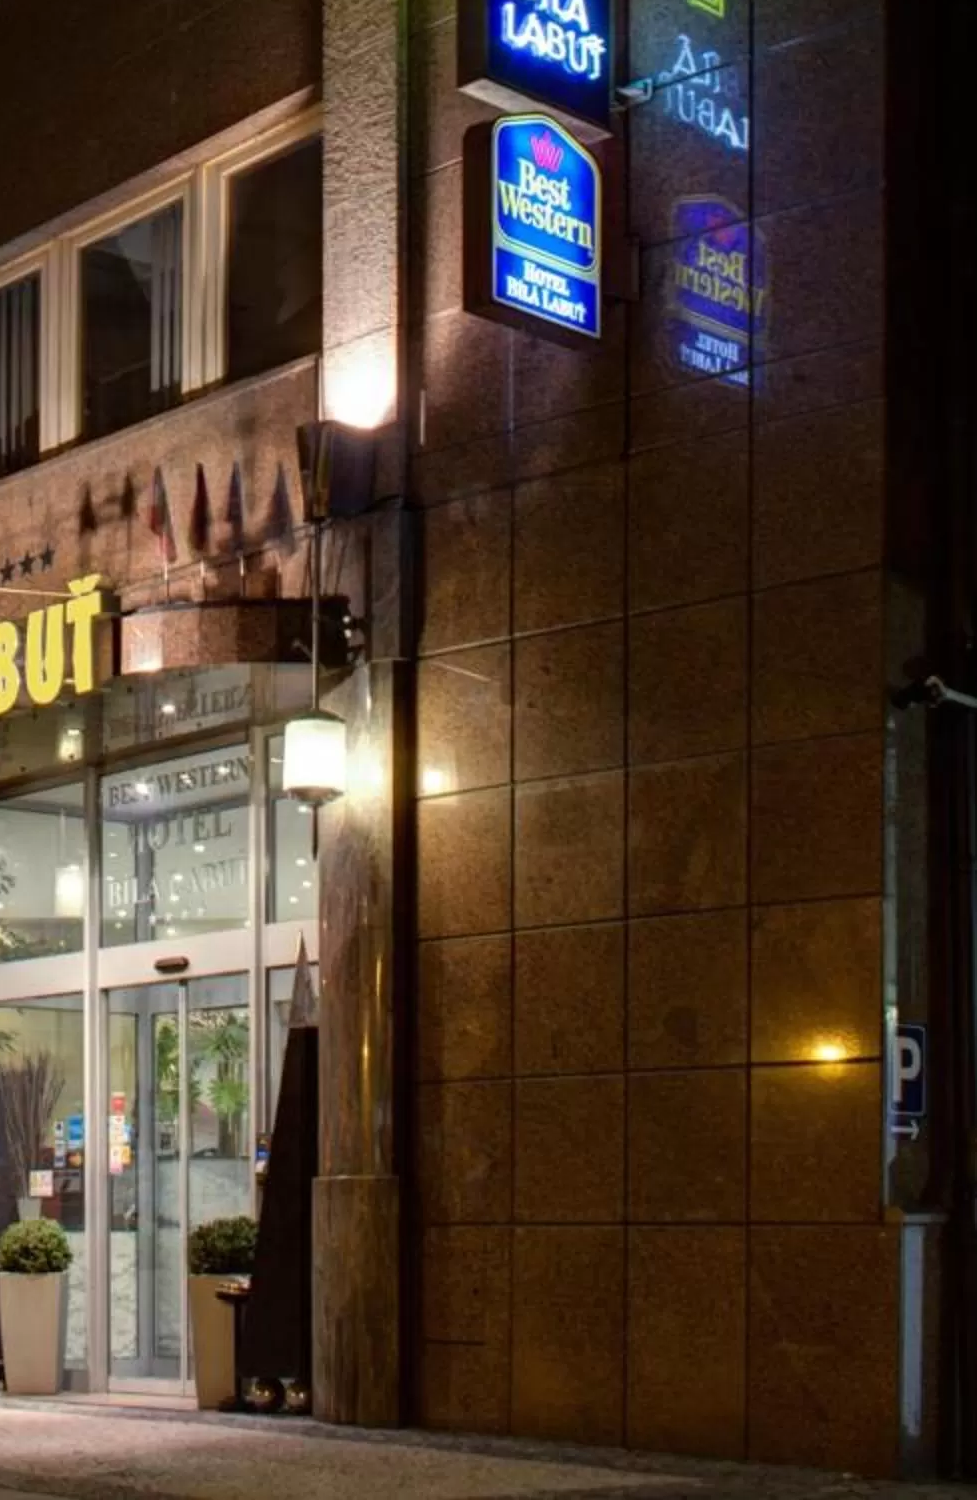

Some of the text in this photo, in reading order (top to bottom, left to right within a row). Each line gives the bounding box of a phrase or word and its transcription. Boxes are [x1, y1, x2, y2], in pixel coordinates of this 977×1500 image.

[517, 157, 572, 211] Best
[498, 178, 593, 249] Western
[522, 259, 571, 297] HOTEL
[109, 776, 154, 807] BE
[892, 1035, 922, 1105] P
